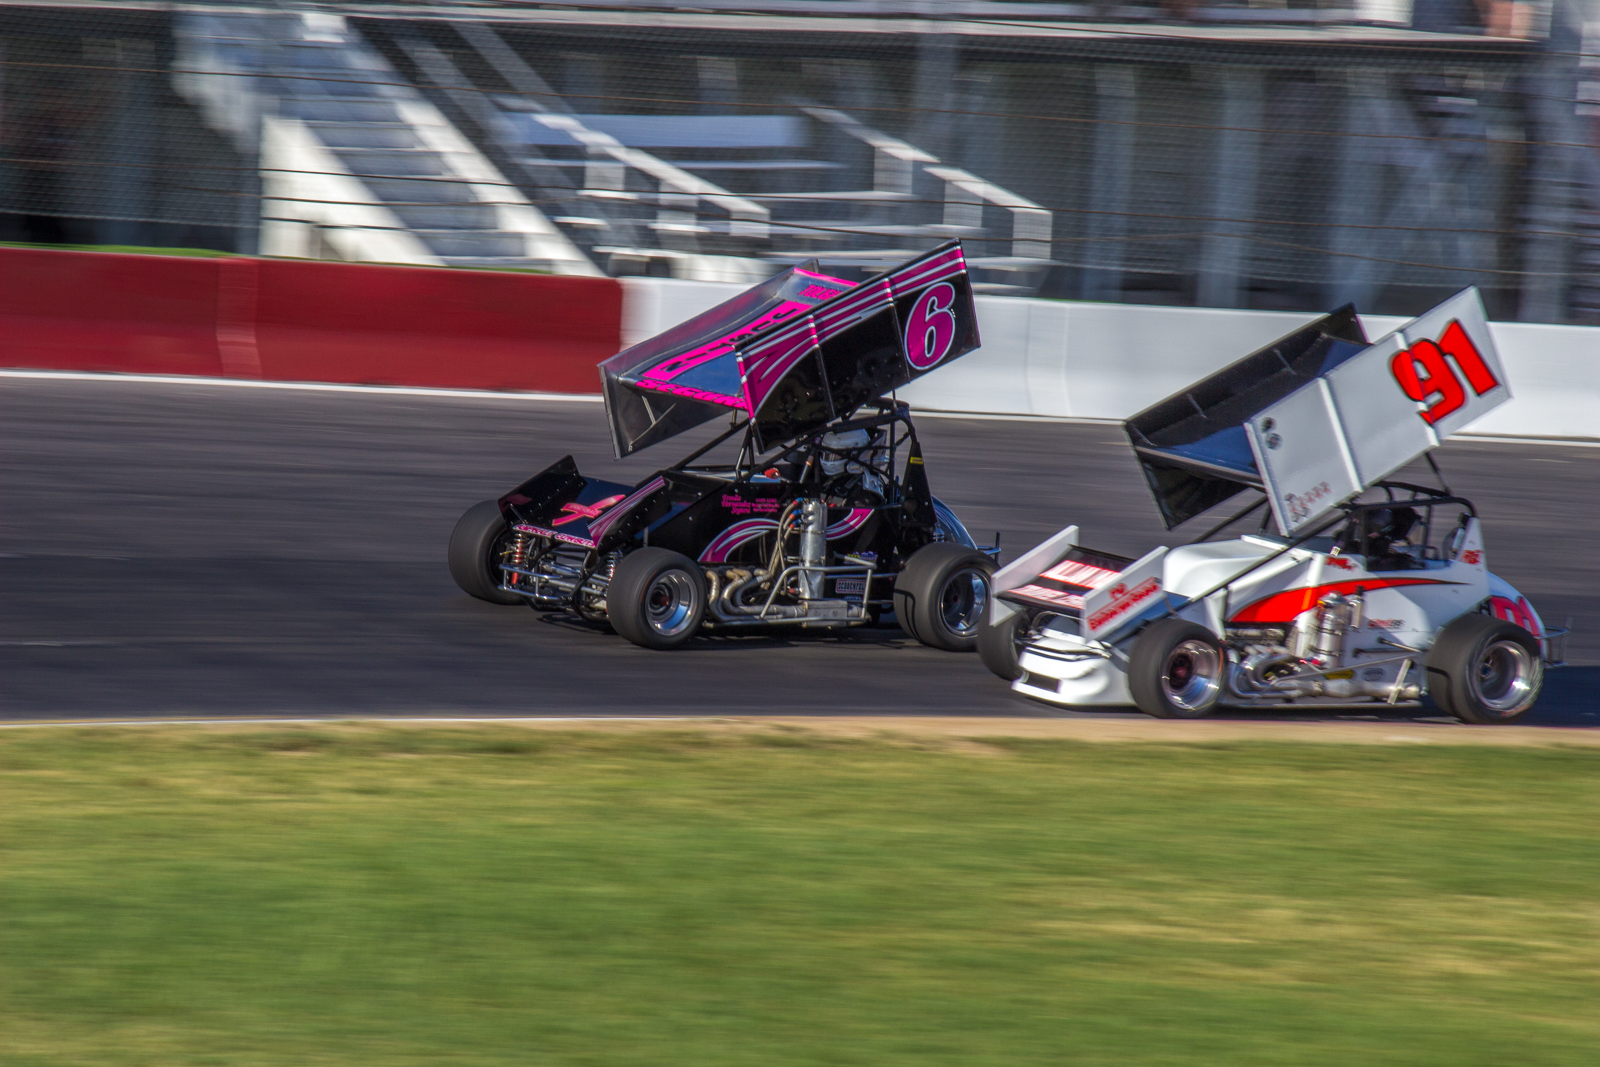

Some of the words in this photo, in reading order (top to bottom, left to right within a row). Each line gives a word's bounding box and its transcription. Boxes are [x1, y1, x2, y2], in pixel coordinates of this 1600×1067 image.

[904, 281, 955, 370] 6
[1388, 318, 1500, 425] 91
[838, 581, 866, 591] SCHOENFEL
